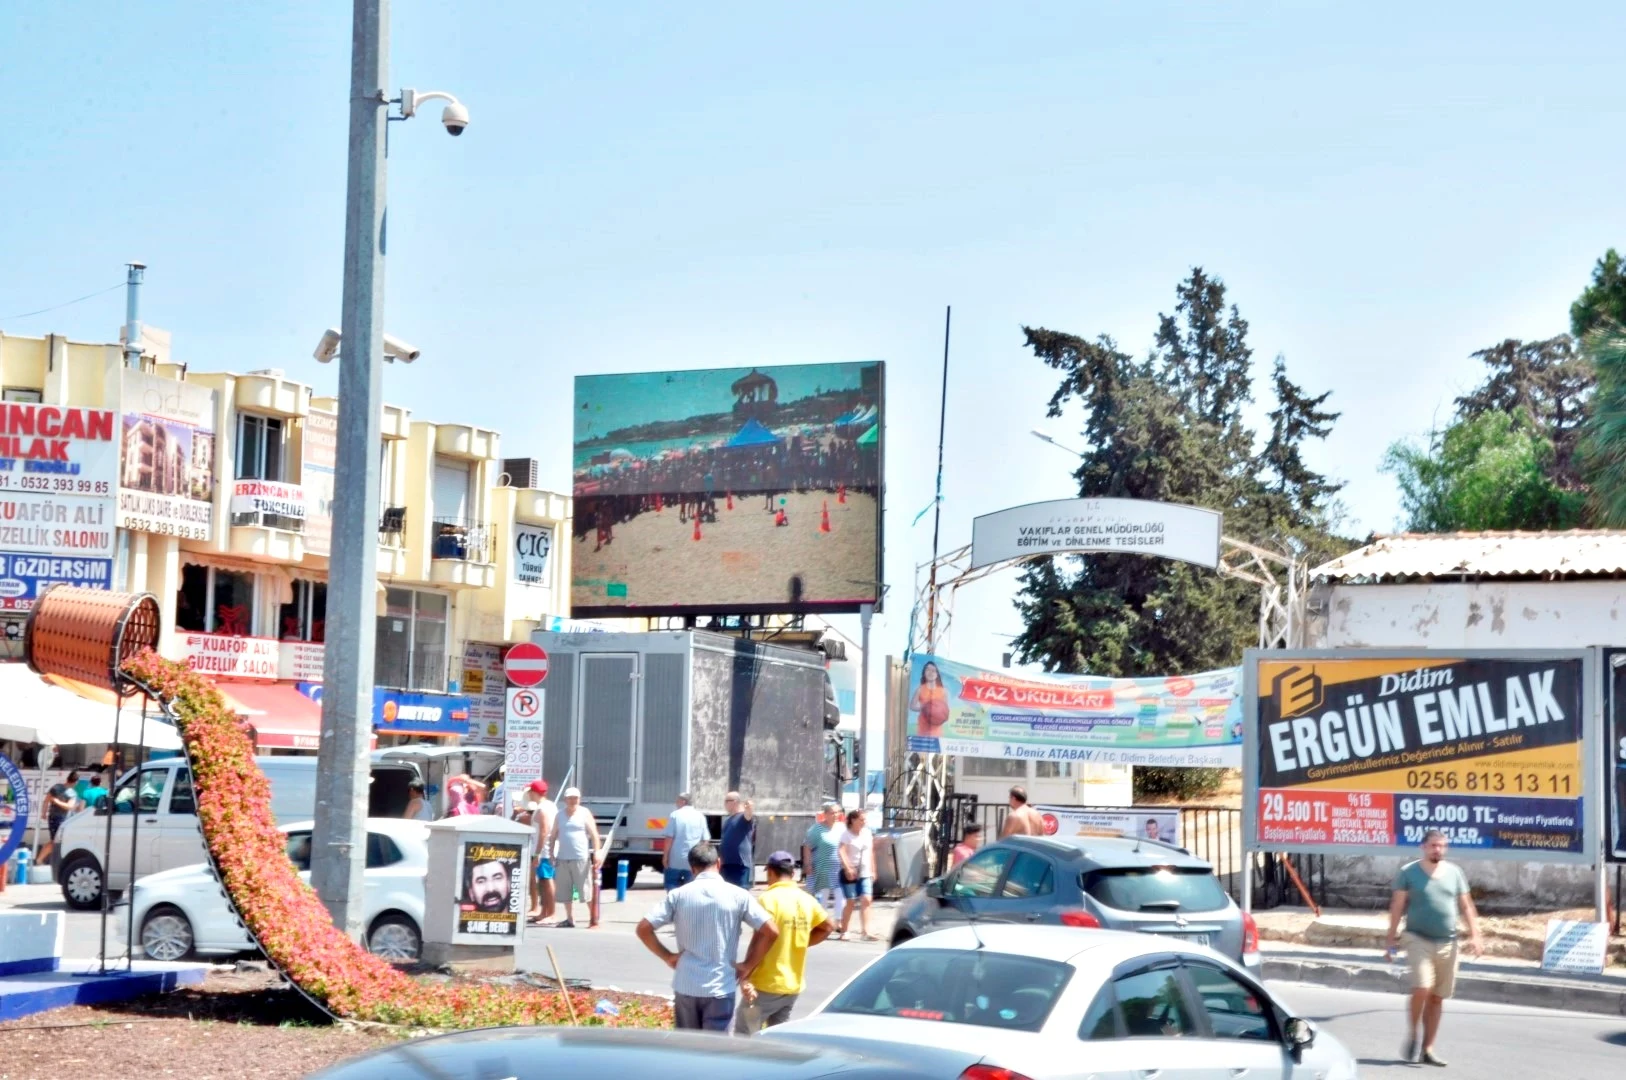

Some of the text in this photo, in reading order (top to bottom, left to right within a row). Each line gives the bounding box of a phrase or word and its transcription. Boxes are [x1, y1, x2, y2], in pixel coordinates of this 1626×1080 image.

[21, 477, 49, 490] 0532
[53, 479, 74, 491] 393
[77, 481, 91, 492] 99
[95, 482, 109, 494] 85
[73, 504, 104, 525] ALİ
[0, 525, 109, 549] ZELLİK SALONU
[124, 516, 207, 541] 0532 393 99 85
[1019, 523, 1165, 535] VAKIFLAR GENEL MÜDÜRLÜĞÜ
[516, 531, 549, 559] ÇIĞ
[1017, 535, 1049, 547] EĞİTİM
[1065, 535, 1111, 546] DİNLENME
[1115, 534, 1165, 545] TESİSLERİ
[14, 557, 107, 580] ÖZDERSİM
[203, 635, 248, 654] KUAFÖR
[188, 652, 239, 672] GÜZELLİK
[1379, 667, 1454, 697] Didim
[974, 685, 1105, 707] YAZ OKULLARI
[1269, 693, 1406, 772] ERGÜN
[1413, 669, 1566, 746] EMLAK
[1048, 747, 1093, 761] ATABAY
[1120, 752, 1146, 763] Didim
[1148, 754, 1185, 765] Belediye
[1187, 755, 1223, 767] Başkanı
[1307, 754, 1399, 779] Gayrimenkulleriniz
[1401, 745, 1455, 764] Değerinde
[1457, 740, 1485, 754] Alınır
[1492, 734, 1524, 749] Satılır
[1406, 770, 1571, 794] 0256 813 13 11
[1263, 793, 1311, 823] 29.500
[1399, 798, 1469, 822] 95.000
[1497, 813, 1574, 828] Başlayan Fiyatlarla
[1264, 825, 1327, 843] Başlayan Fiyatlarla
[1333, 829, 1390, 844] ARSALAR
[1511, 839, 1570, 849] ALTINKUM
[509, 867, 522, 913] KONSER
